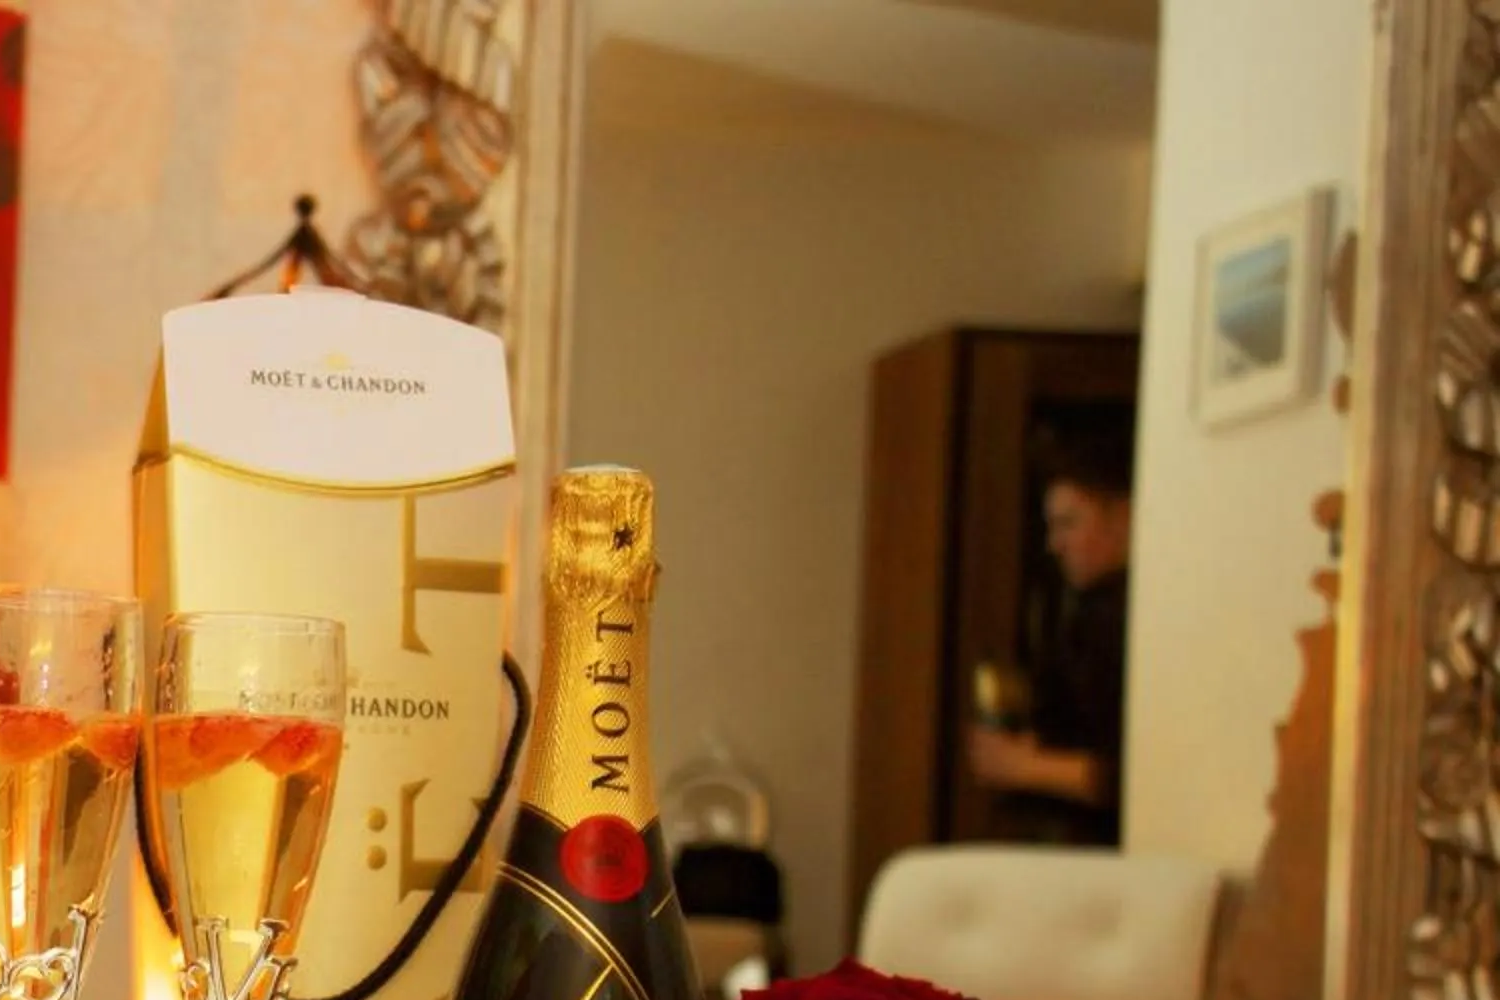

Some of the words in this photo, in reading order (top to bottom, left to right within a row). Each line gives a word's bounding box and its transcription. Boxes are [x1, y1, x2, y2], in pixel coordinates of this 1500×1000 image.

[251, 369, 306, 388] MOËT
[310, 375, 323, 389] &
[326, 374, 426, 395] CHANDON
[350, 696, 450, 720] HANDON
[586, 610, 633, 793] MOËT
